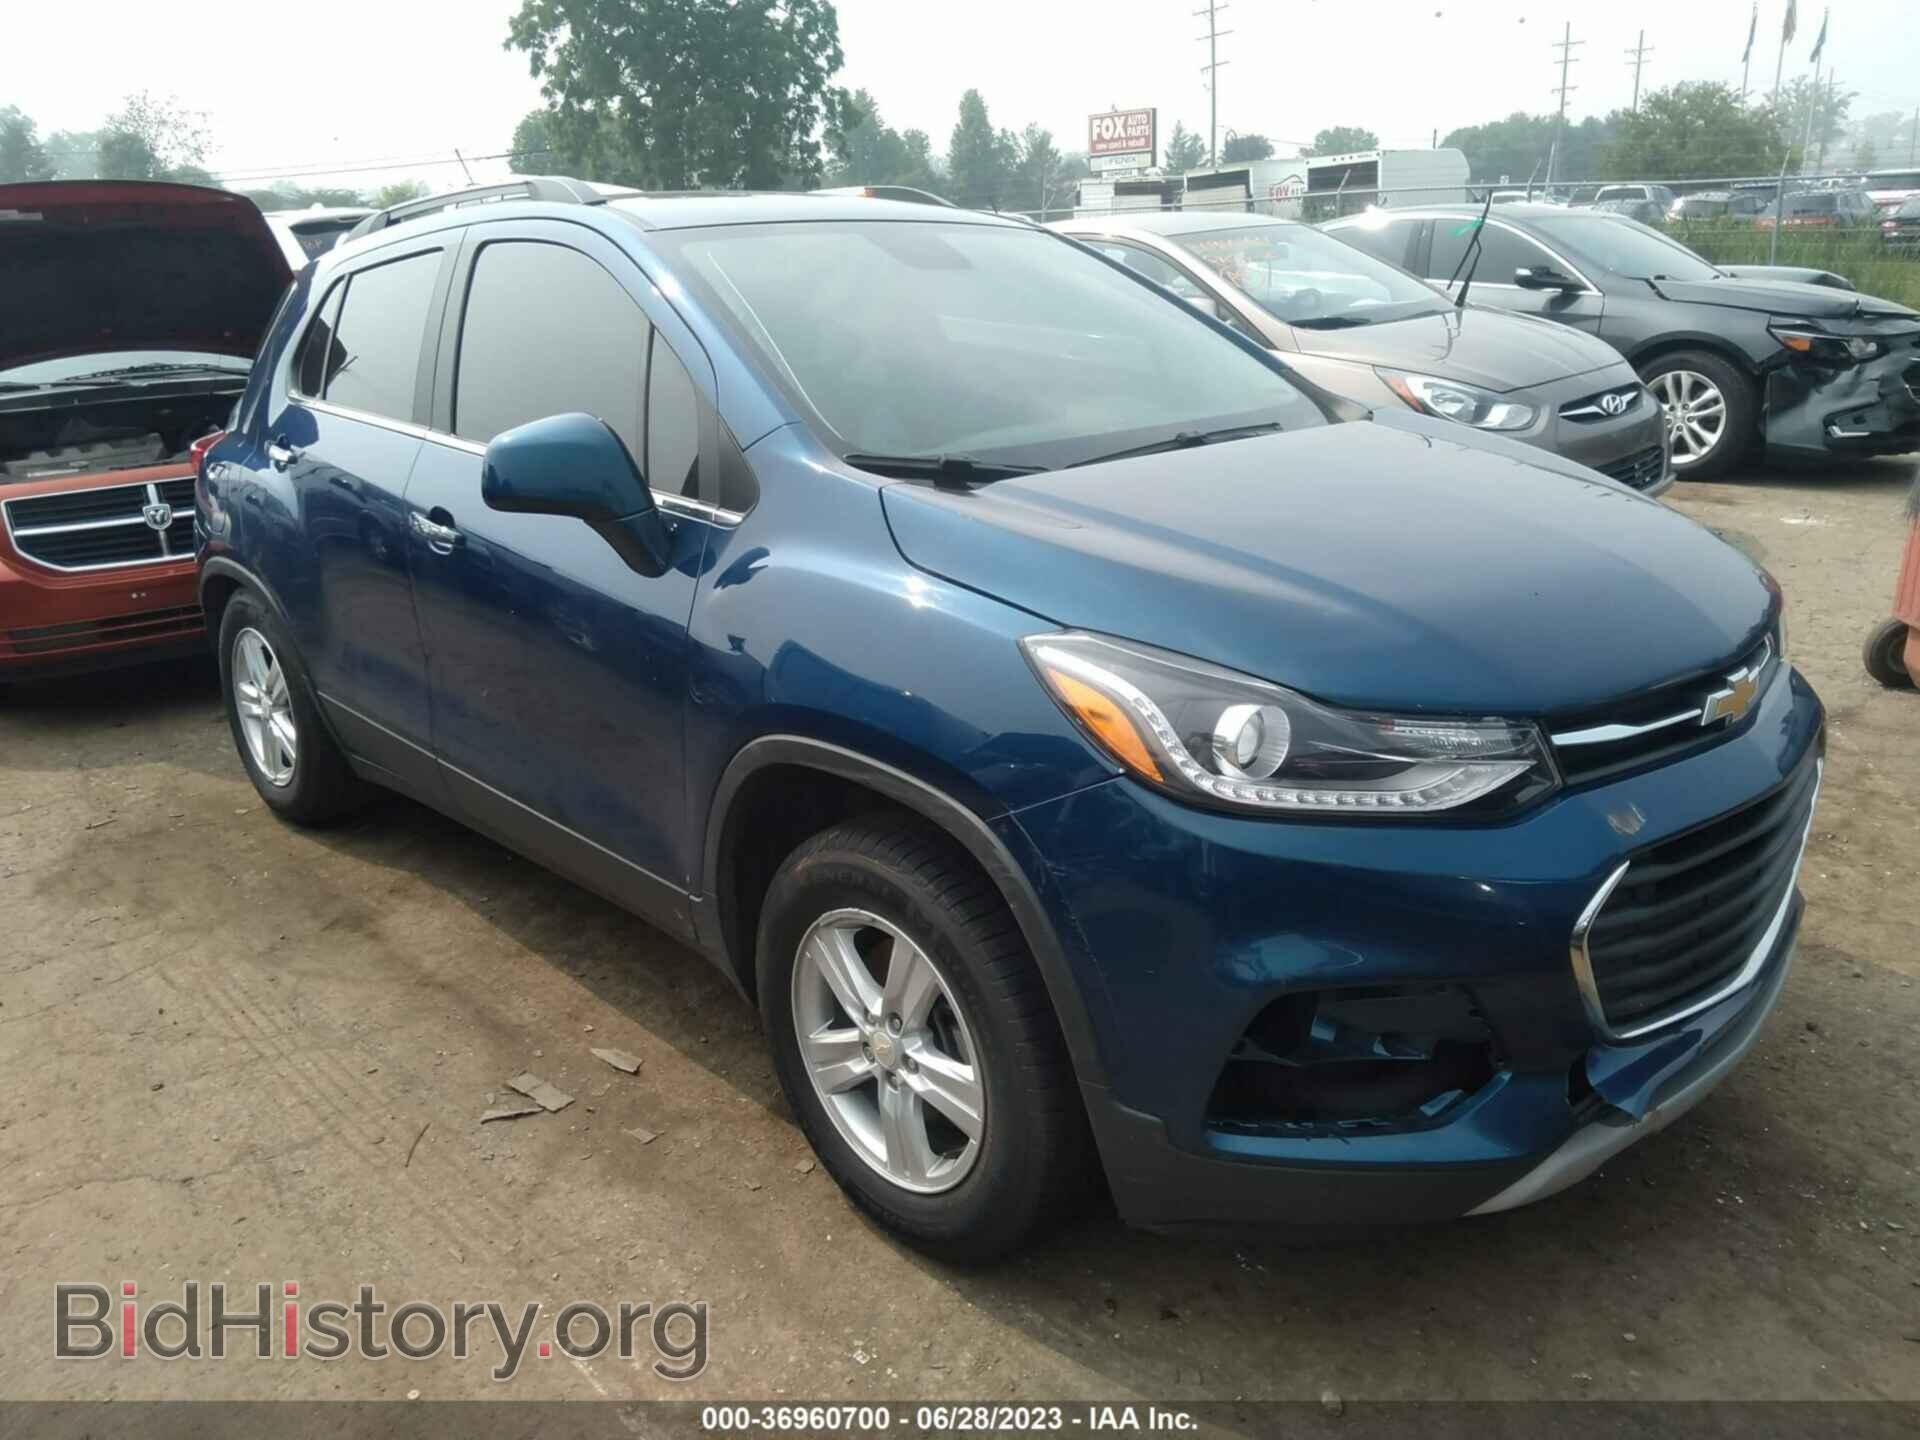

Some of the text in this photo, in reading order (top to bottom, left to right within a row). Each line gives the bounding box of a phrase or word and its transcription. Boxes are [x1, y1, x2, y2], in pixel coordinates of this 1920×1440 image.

[1127, 113, 1148, 125] AUTO
[1092, 116, 1126, 141] FOX
[1126, 125, 1149, 137] PARTS
